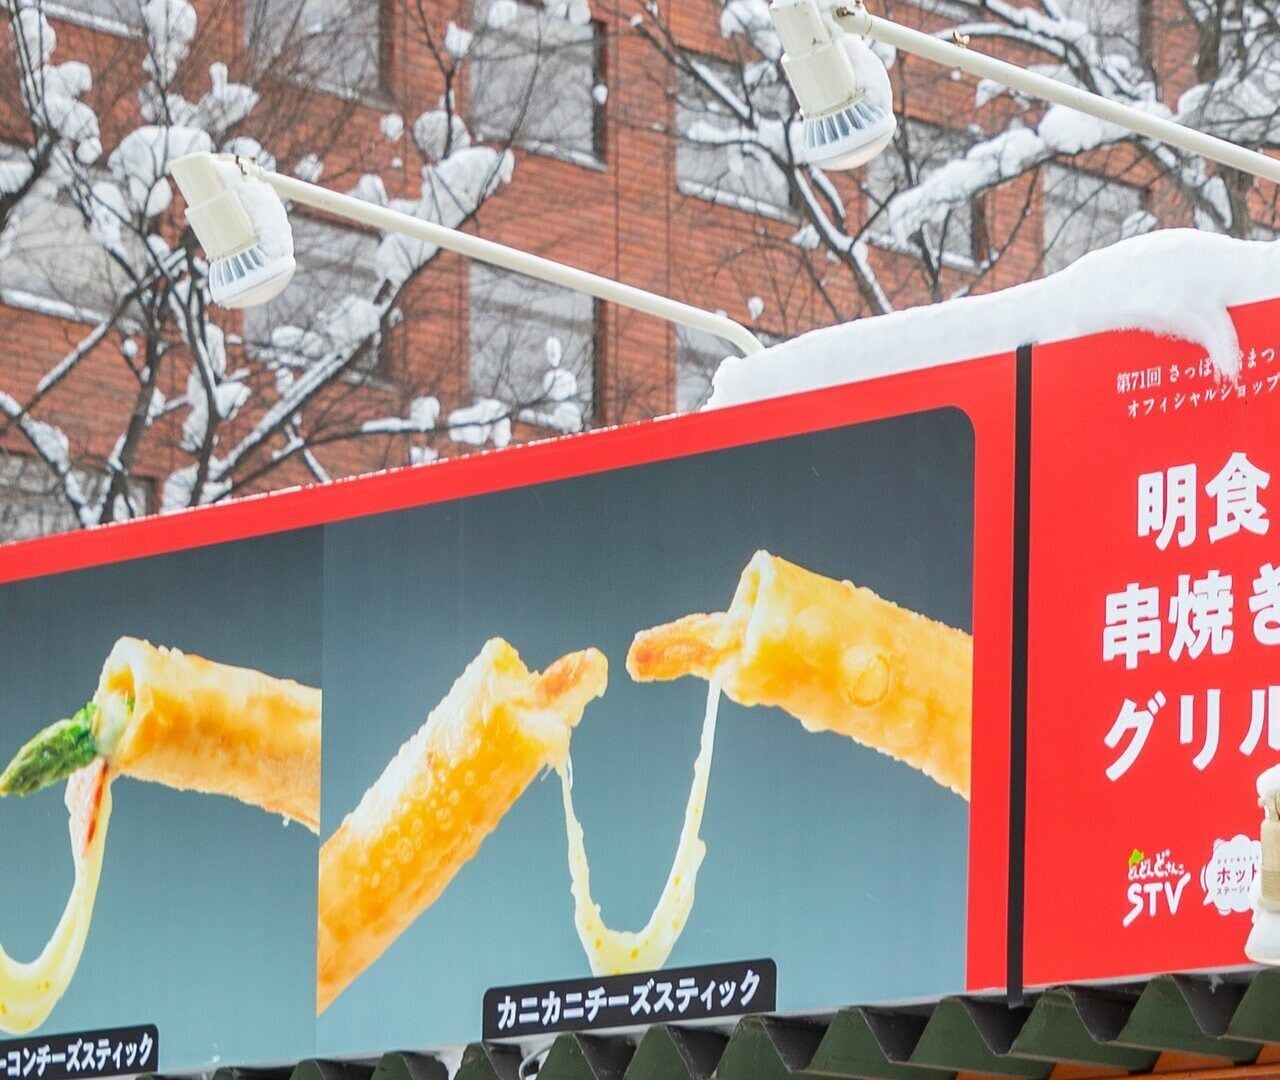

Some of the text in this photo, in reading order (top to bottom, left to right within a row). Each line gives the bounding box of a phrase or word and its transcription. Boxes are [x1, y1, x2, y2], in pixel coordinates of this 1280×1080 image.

[1116, 366, 1162, 394] 第71回
[1136, 451, 1271, 552] 明食
[1122, 872, 1191, 927] STV
[498, 969, 760, 1030] カニカニチーズスティック
